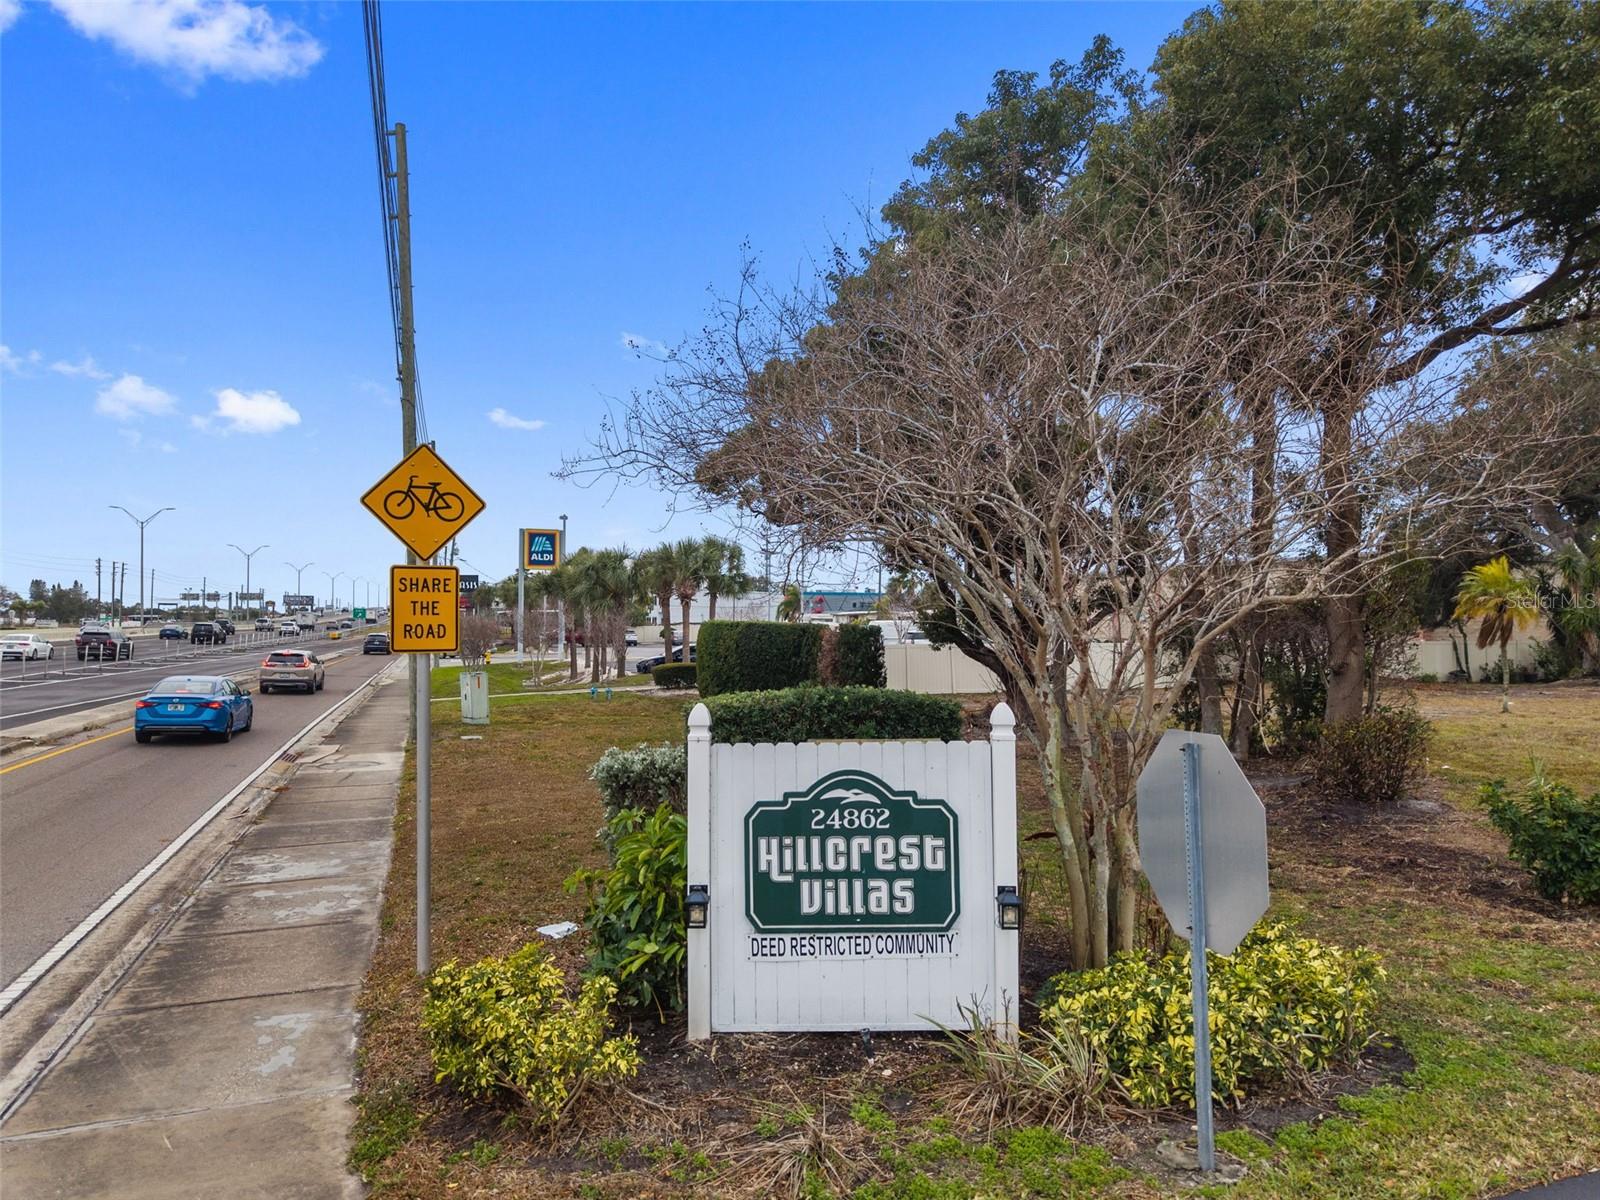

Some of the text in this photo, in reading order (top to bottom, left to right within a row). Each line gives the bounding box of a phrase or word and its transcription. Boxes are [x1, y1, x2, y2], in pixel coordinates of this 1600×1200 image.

[531, 553, 553, 561] ALDI
[399, 577, 452, 593] SHARE
[411, 601, 440, 616] THE
[404, 624, 447, 639] ROAD
[811, 808, 890, 829] 24862
[758, 835, 946, 883] Hillcrest
[800, 878, 915, 915] Villas
[751, 933, 954, 957] DEED RESTRICTED COMMUNITY
